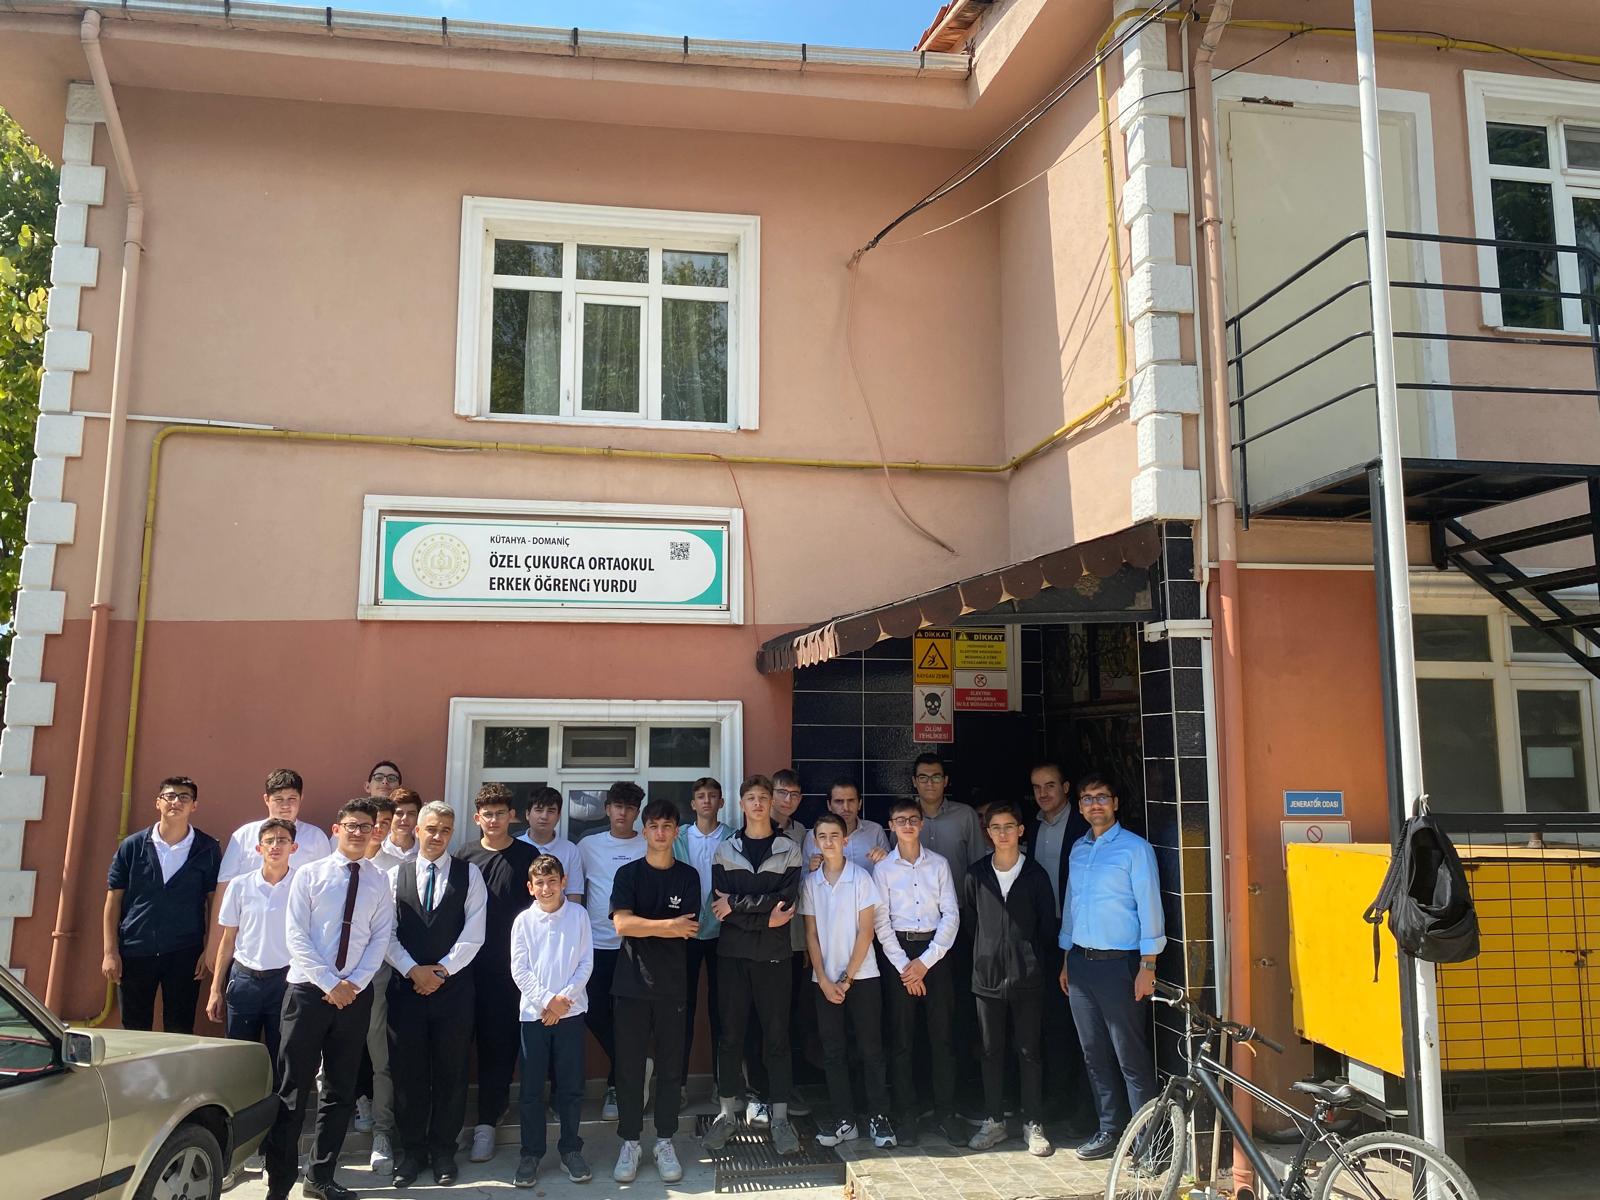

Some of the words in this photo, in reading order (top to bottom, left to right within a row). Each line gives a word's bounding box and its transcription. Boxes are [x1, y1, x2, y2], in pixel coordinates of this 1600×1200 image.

[490, 535, 527, 545] KÜTAHYA
[532, 537, 570, 547] DOMANİÇ
[489, 551, 521, 569] ÖZEL
[524, 554, 585, 572] ÇUKURCA
[588, 556, 655, 571] ORTAOKUL
[489, 577, 531, 591] ERKEK
[593, 579, 637, 593] YURDU
[924, 630, 950, 638] DİKKAT
[973, 632, 1003, 641] DİKKAT
[1290, 799, 1321, 808] JENERATÖR
[1322, 800, 1339, 808] ODASI
